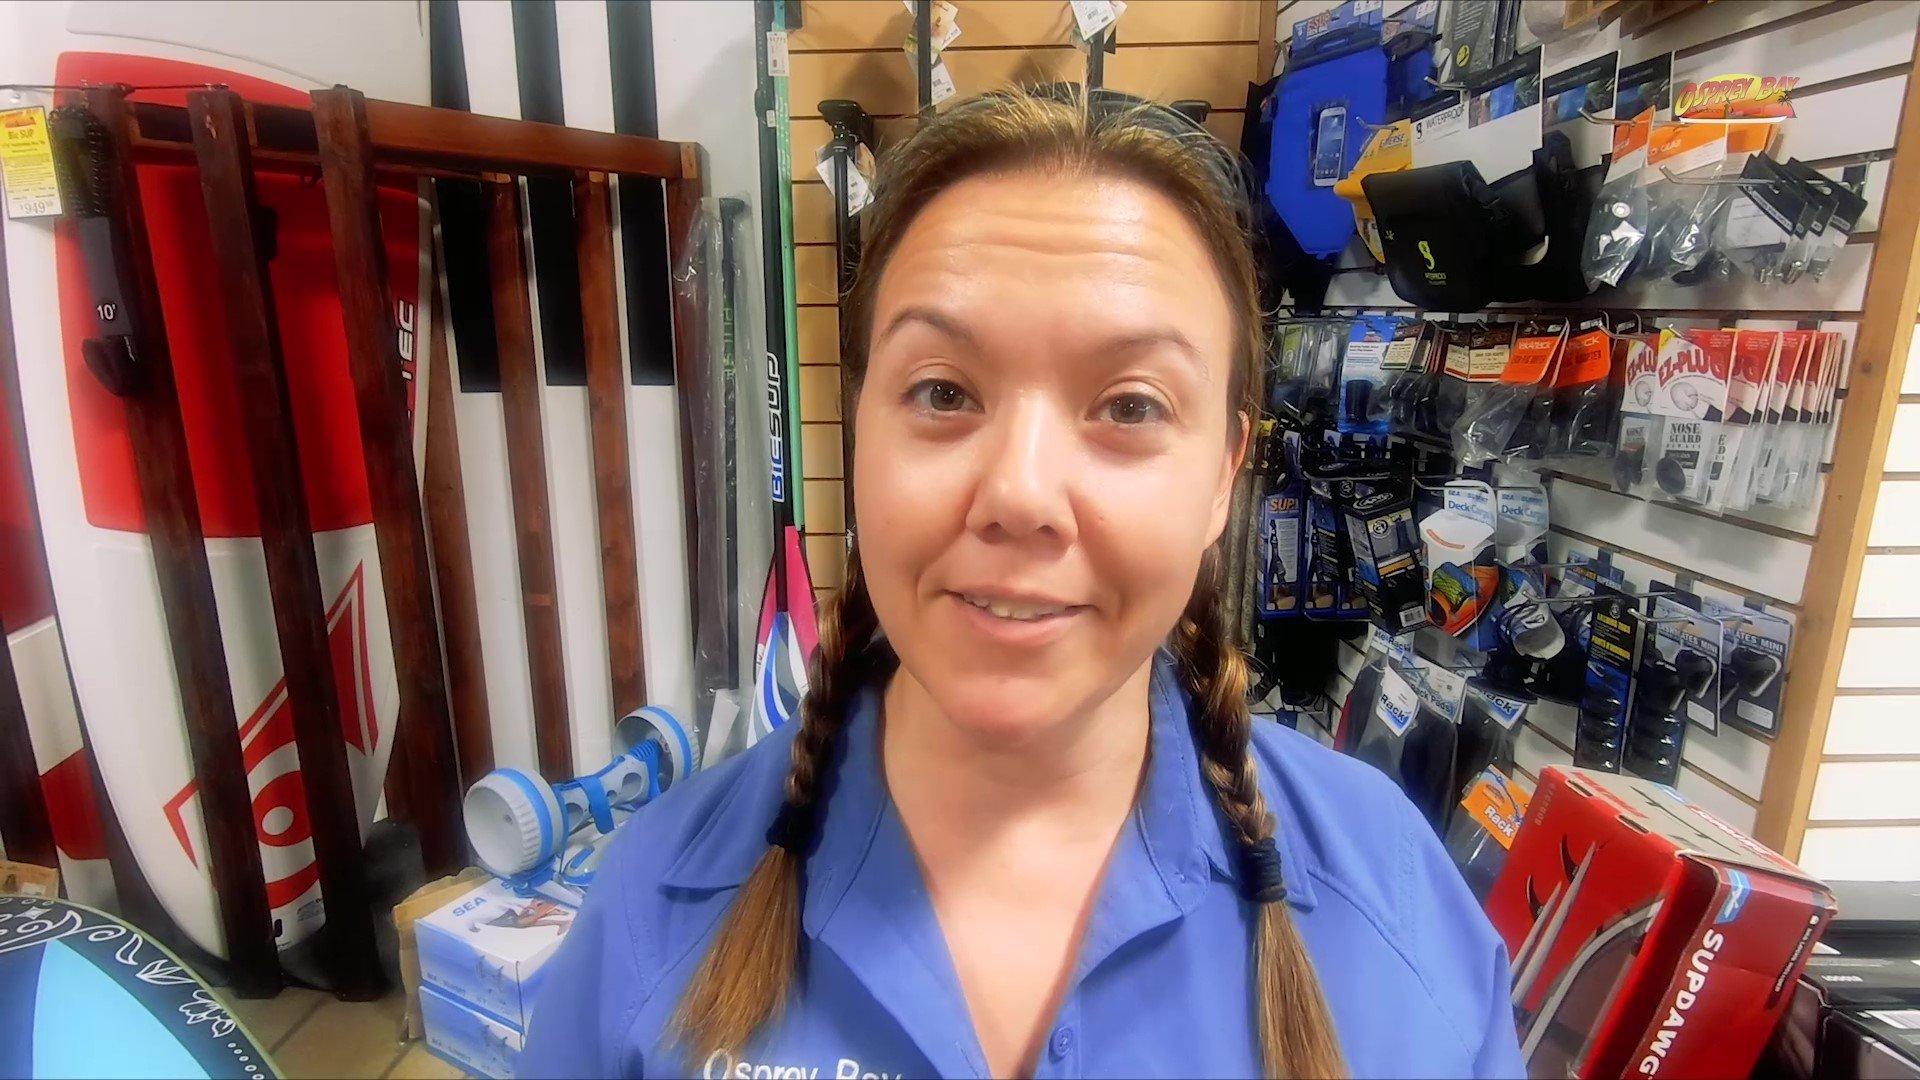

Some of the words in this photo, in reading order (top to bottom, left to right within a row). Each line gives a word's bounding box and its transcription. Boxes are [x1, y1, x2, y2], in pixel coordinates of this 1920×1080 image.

[1426, 105, 1464, 129] WATERPROOF
[97, 304, 116, 320] 10'
[399, 299, 413, 380] EC
[1671, 422, 1700, 434] NOSE
[1760, 638, 1783, 653] MINI
[1381, 694, 1405, 721] Rack
[1483, 691, 1512, 715] ack
[1485, 805, 1514, 837] Rack
[453, 896, 487, 917] SEA
[1639, 929, 1724, 1076] SUPDAWG
